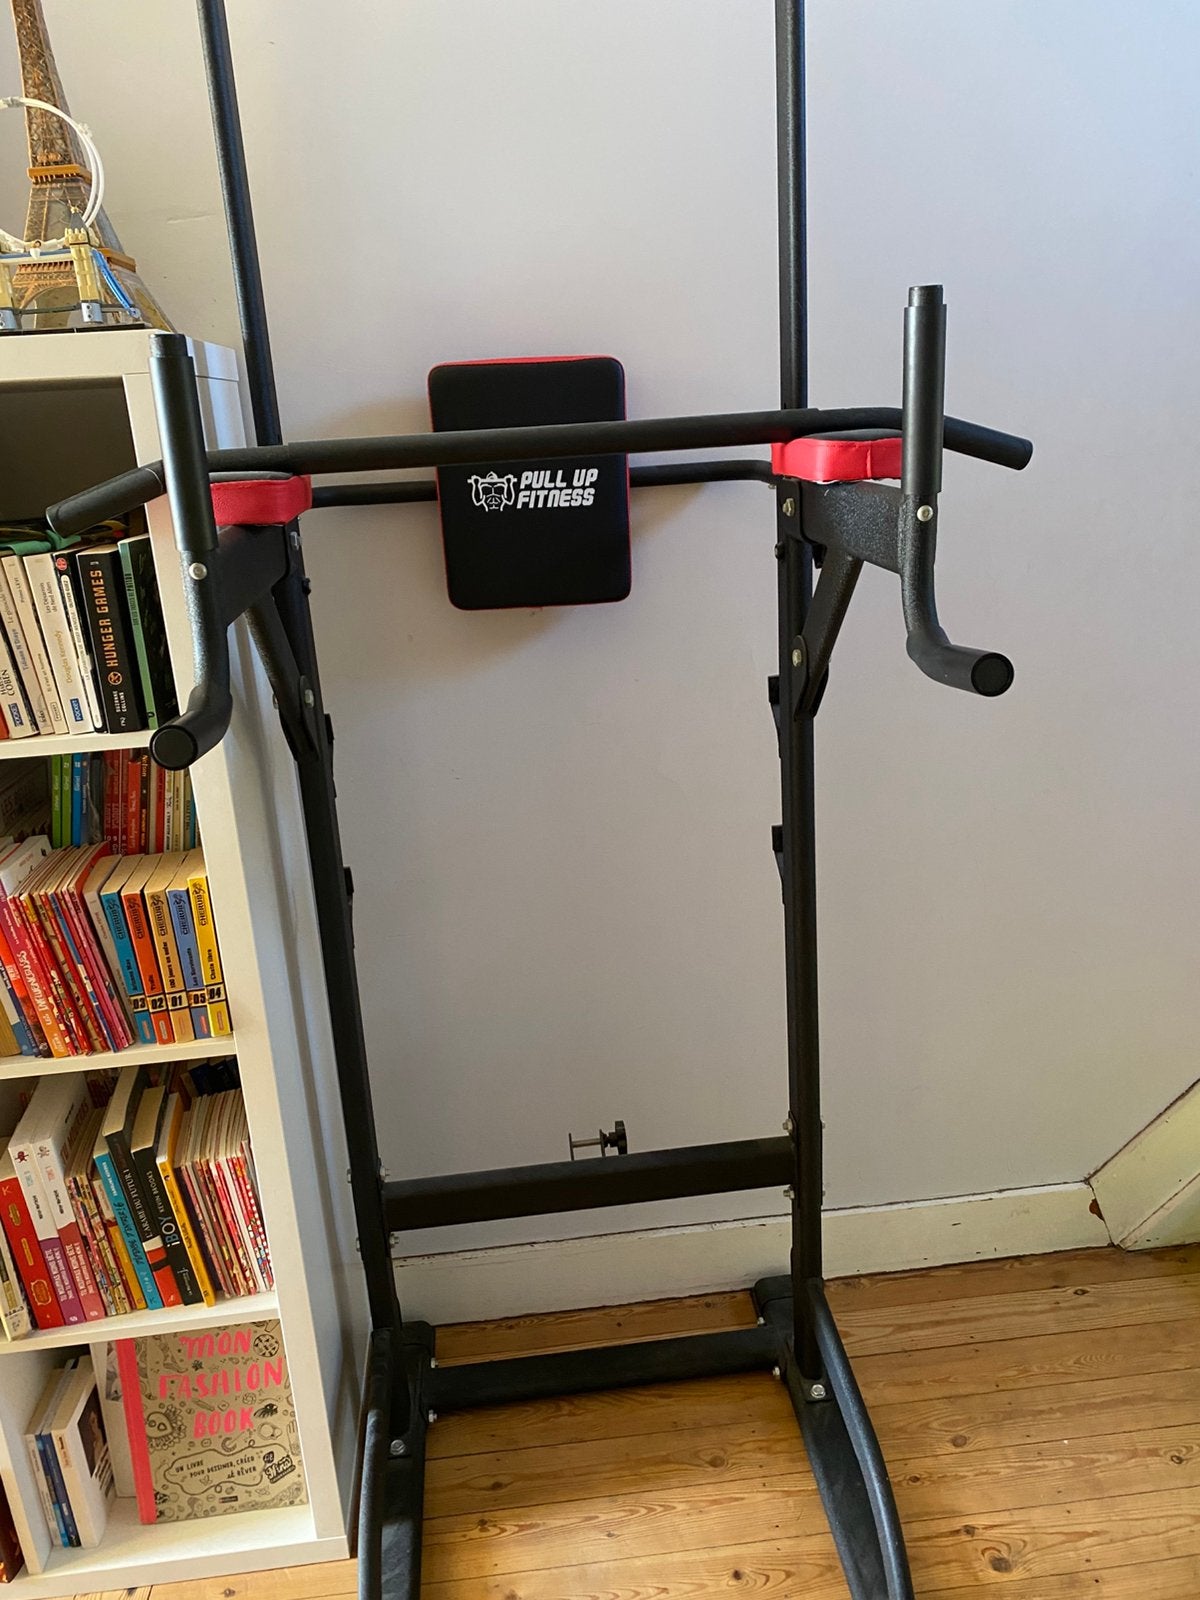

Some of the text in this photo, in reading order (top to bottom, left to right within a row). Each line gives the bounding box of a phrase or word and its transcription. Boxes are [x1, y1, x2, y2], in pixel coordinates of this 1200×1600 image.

[520, 468, 598, 489] PULL UP
[517, 488, 596, 509] FITNESS
[90, 569, 109, 614] GAMES
[98, 618, 119, 667] HUNGER
[55, 630, 72, 683] Douglas Kennedy
[1, 669, 15, 697] COBEN
[72, 700, 81, 721] POCKET
[112, 690, 121, 712] SUZANNE
[119, 692, 127, 712] COLLINS
[154, 905, 167, 937] CHERUB
[176, 904, 189, 935] CHERUB
[196, 895, 207, 926] CHERUB
[110, 909, 125, 940] CHERUB
[130, 908, 144, 940] CHERUB
[161, 942, 169, 956] enfer
[166, 964, 174, 978] jours
[186, 948, 196, 975] Survivants
[16, 950, 48, 1012] INFLUENCEUSES
[133, 997, 146, 1008] 03
[151, 996, 164, 1008] 02
[171, 994, 182, 1006] 01
[193, 993, 206, 1005] 05
[209, 988, 222, 999] 04
[124, 1171, 138, 1198] FUTUR
[146, 1170, 165, 1213] KEVIN BROOKS
[133, 1198, 142, 1209] DU
[158, 1213, 180, 1247] iBOY
[53, 1274, 65, 1295] MOURRAS
[73, 1269, 85, 1290] MOURRAS
[59, 1294, 67, 1302] TU
[180, 1328, 252, 1360] MON
[158, 1356, 283, 1400] FASHION
[193, 1407, 254, 1439] BOOK
[187, 1460, 204, 1470] LIVRE
[190, 1469, 205, 1478] POUR
[237, 1466, 256, 1477] RÊVER
